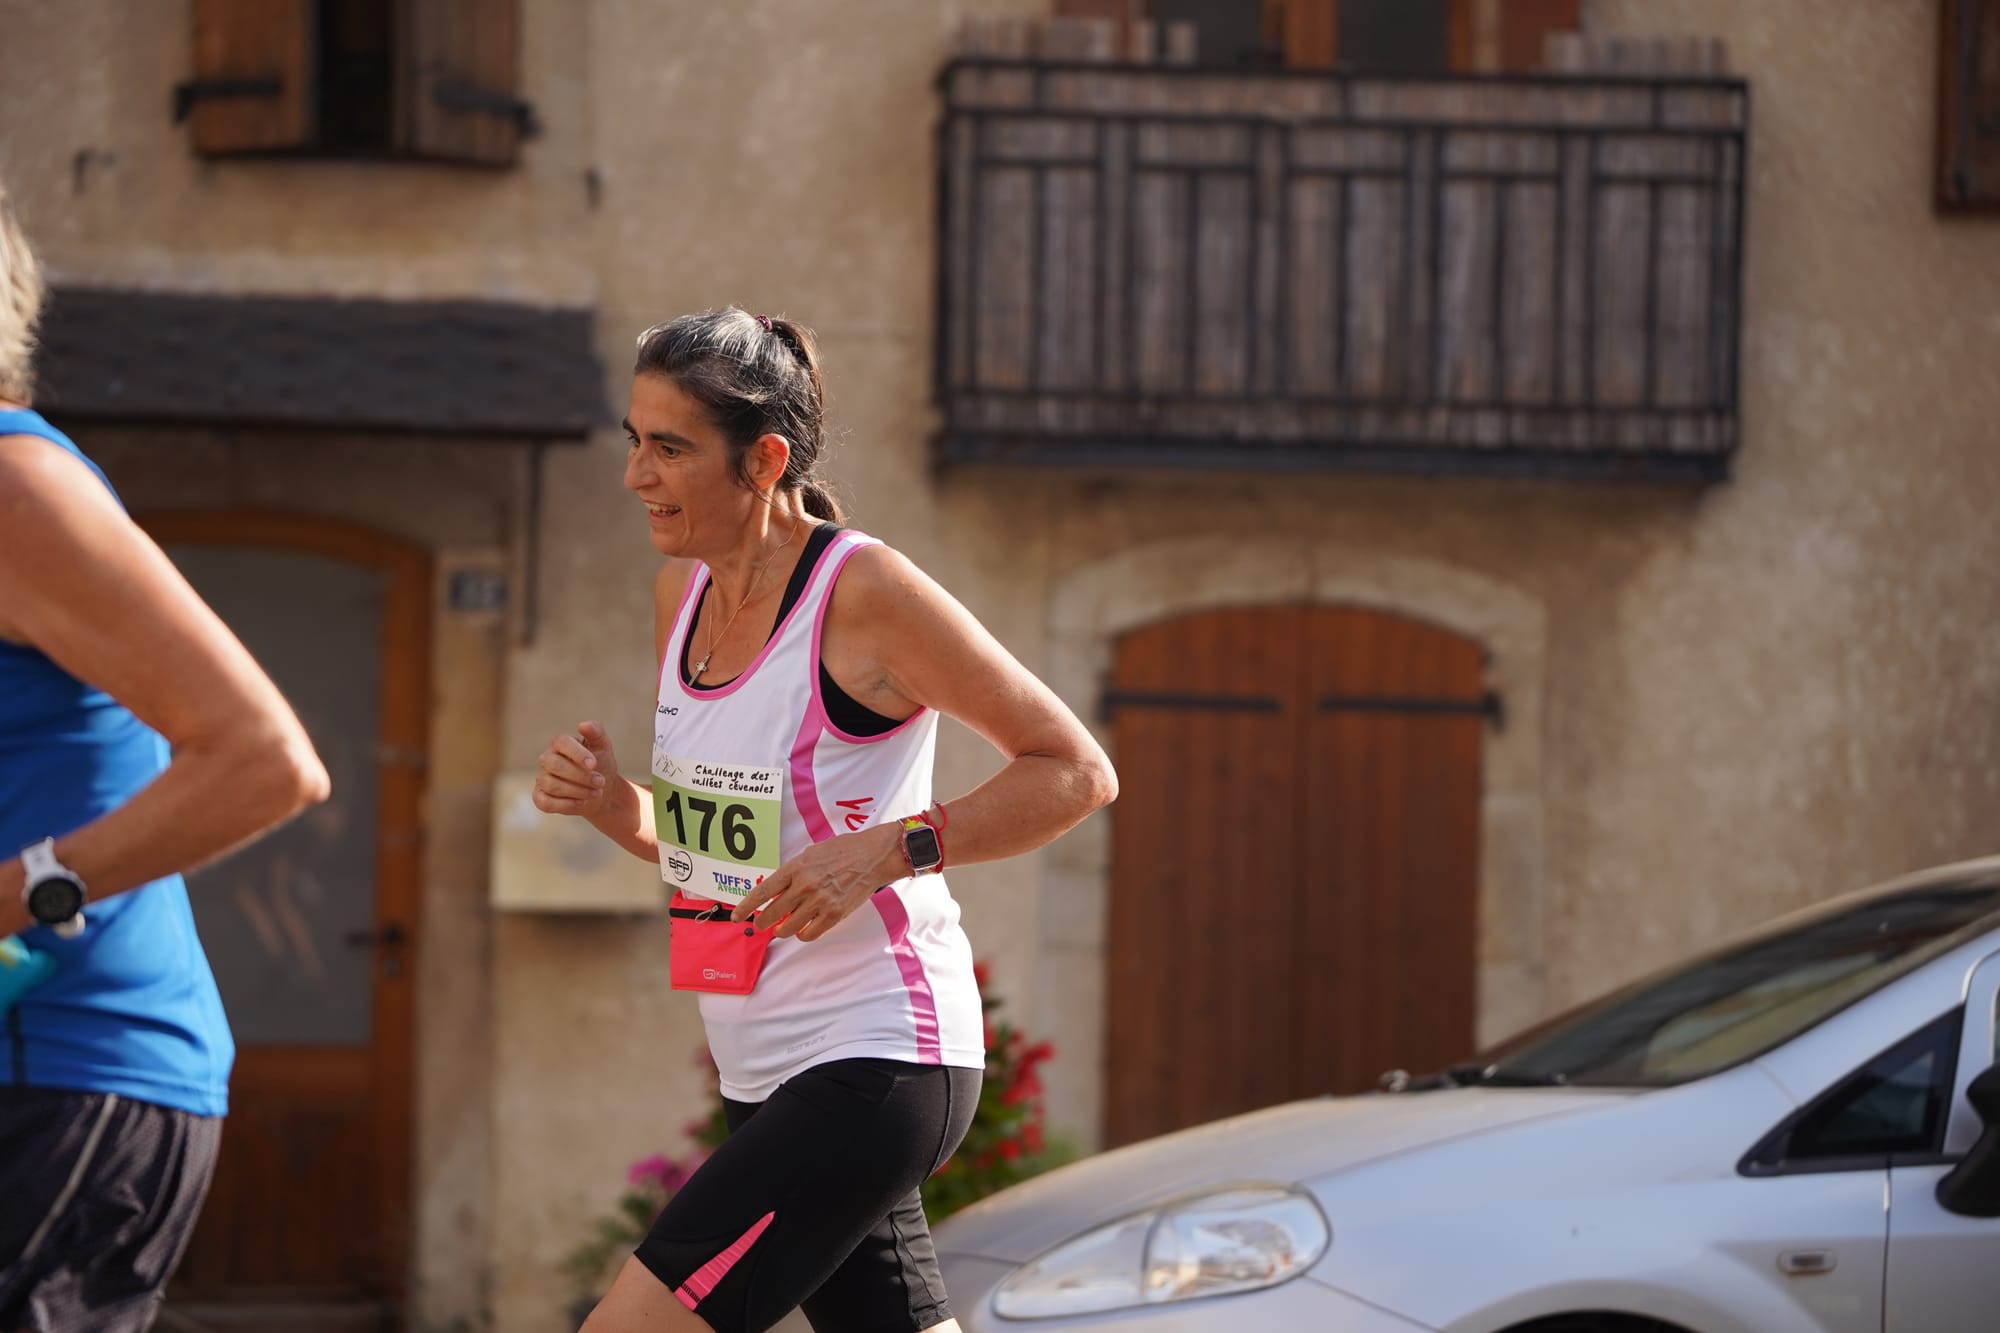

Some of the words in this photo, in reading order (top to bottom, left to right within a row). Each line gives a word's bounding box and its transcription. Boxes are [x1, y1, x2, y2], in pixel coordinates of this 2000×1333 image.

[694, 764, 745, 782] Challenge
[750, 769, 770, 781] des
[691, 776, 723, 789] vallées
[728, 779, 775, 794] cévenoles
[665, 790, 757, 861] 176
[668, 856, 690, 873] BFP
[712, 871, 752, 890] TUFF'S
